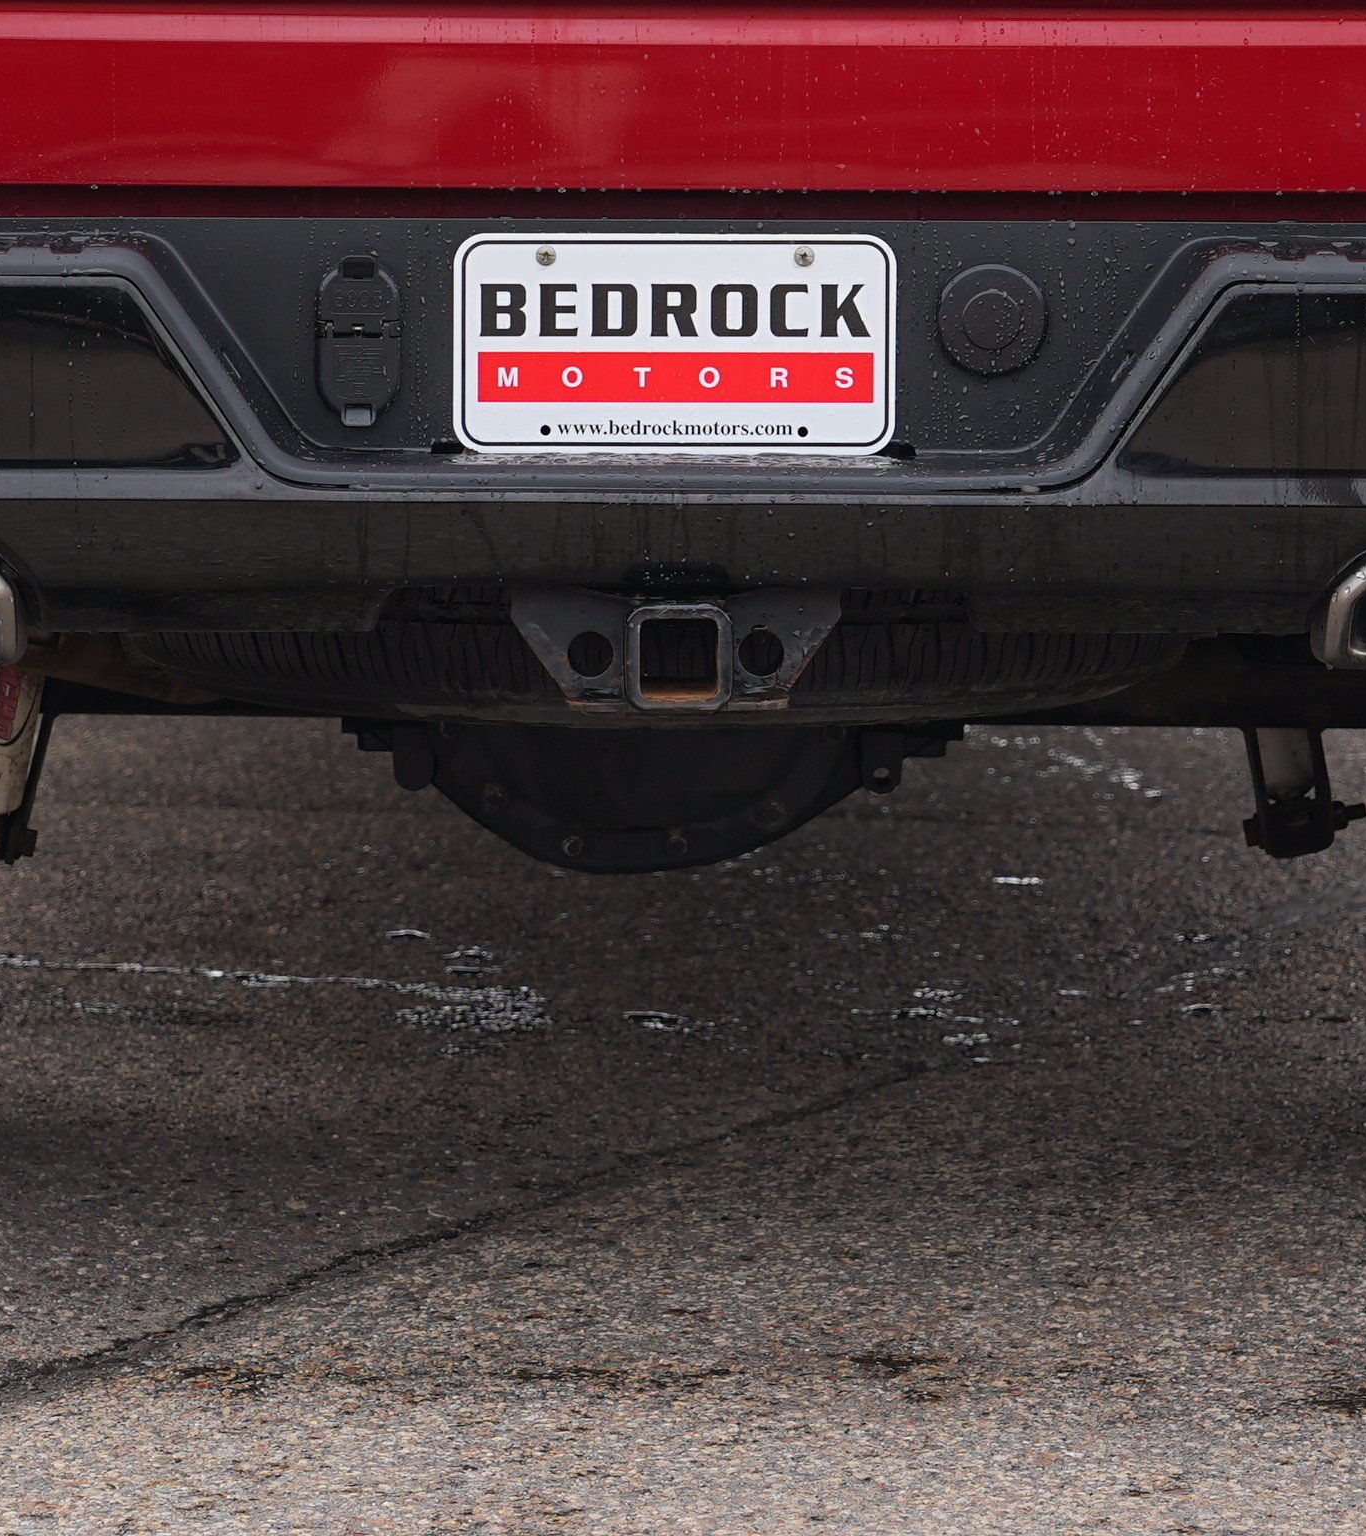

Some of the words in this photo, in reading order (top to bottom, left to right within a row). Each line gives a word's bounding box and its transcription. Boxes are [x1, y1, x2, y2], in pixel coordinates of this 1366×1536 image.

[479, 282, 872, 338] BEDROCK
[496, 365, 855, 389] MOTORS
[557, 420, 795, 438] www.bedrockmotors.com
